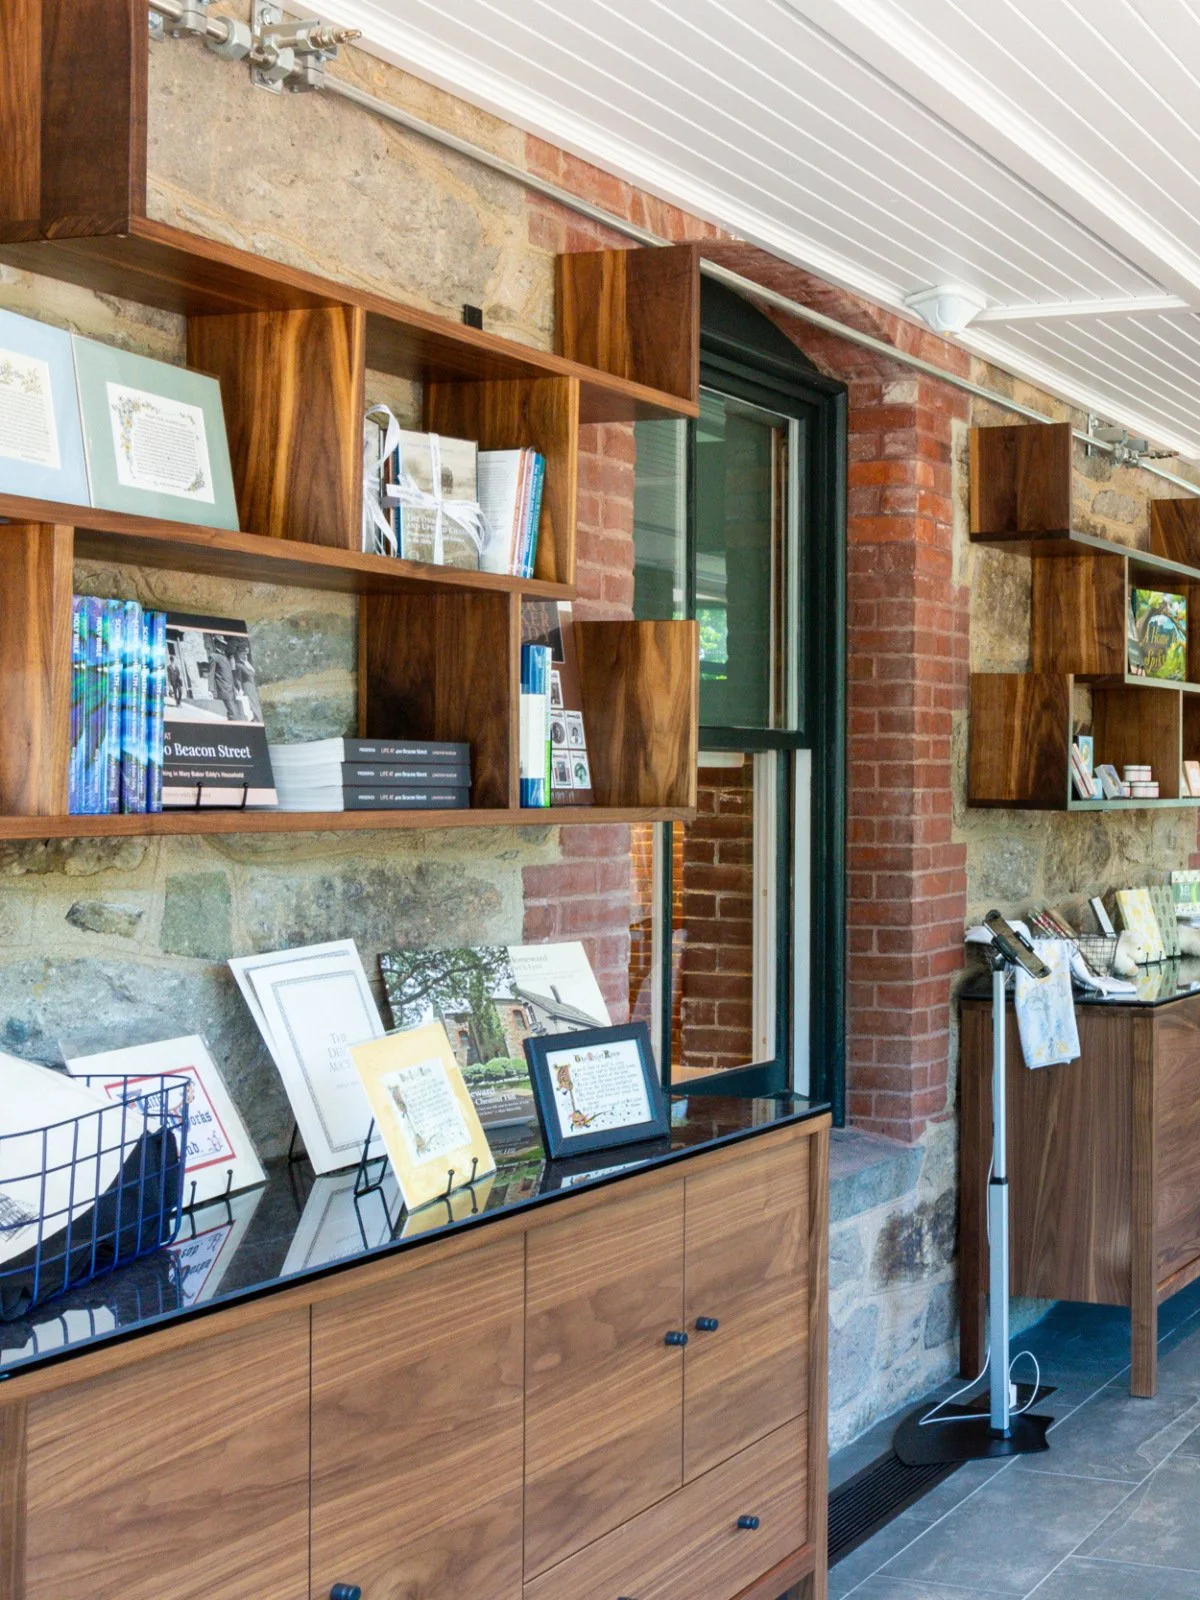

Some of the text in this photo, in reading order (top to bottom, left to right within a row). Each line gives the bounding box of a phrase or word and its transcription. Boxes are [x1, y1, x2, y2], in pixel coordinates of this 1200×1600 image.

[174, 742, 216, 757] Beacon
[218, 745, 252, 759] Street
[470, 1086, 495, 1098] eward
